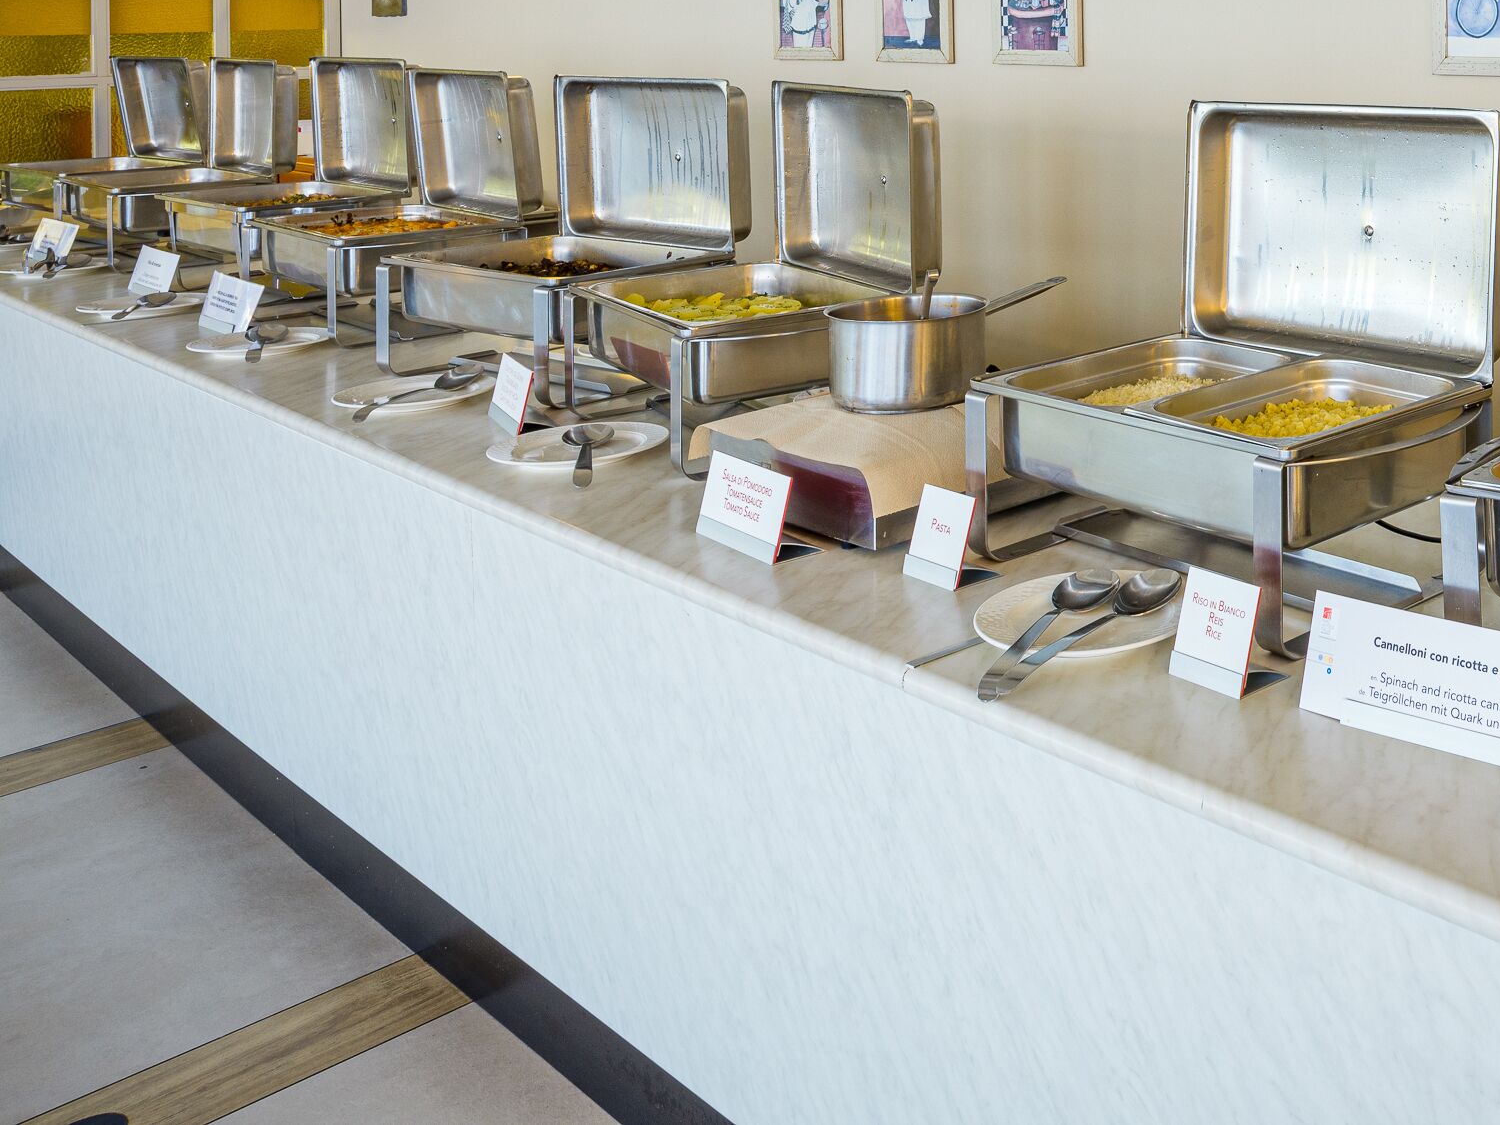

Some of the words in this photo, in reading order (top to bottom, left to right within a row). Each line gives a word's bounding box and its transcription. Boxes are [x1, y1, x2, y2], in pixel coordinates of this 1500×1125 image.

[1373, 636, 1427, 659] Cannelloni
[1430, 652, 1449, 664] con
[1451, 656, 1488, 673] ricotta
[1492, 665, 1499, 675] e
[1368, 685, 1428, 712] Teigröllchen
[1431, 704, 1448, 717] mit
[1450, 707, 1483, 725] Quark
[1379, 672, 1418, 692] Spinach
[1421, 685, 1441, 697] and
[1443, 689, 1478, 706] ricotta
